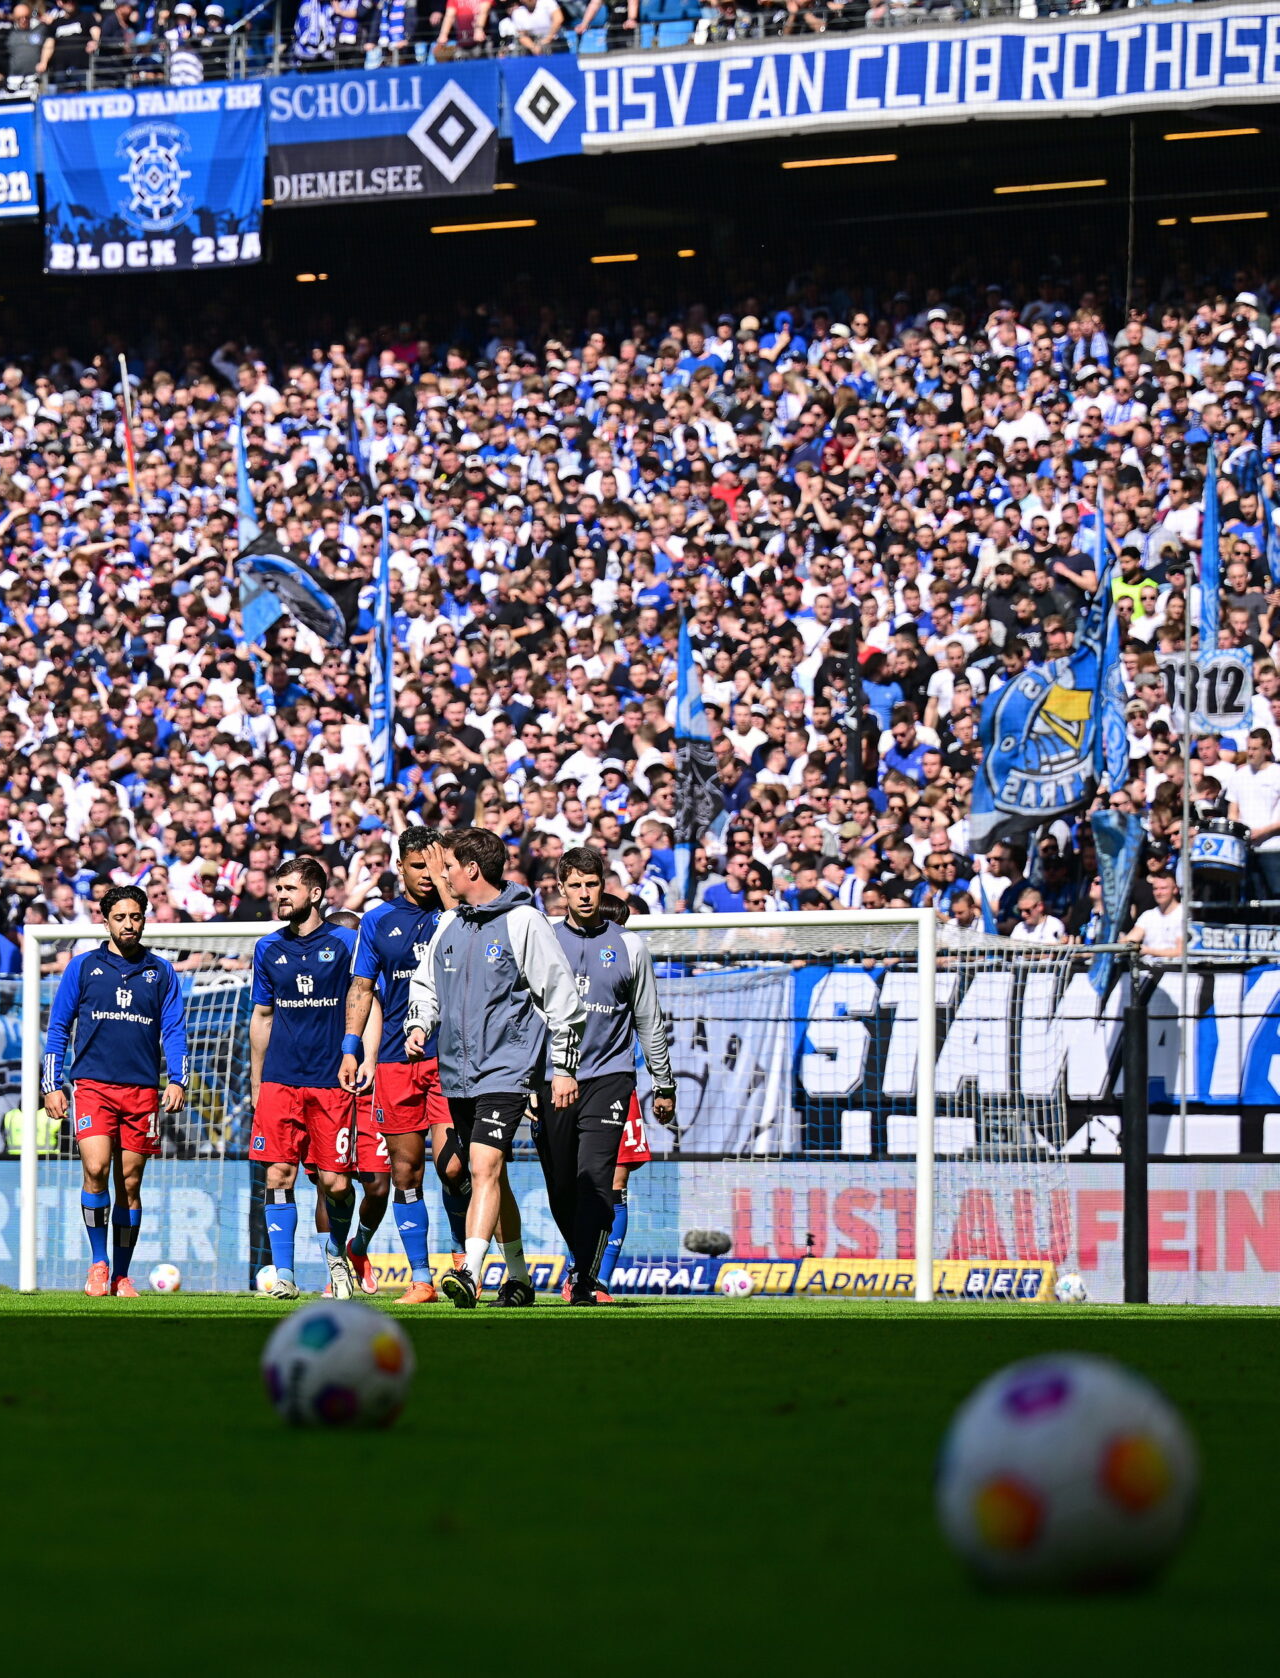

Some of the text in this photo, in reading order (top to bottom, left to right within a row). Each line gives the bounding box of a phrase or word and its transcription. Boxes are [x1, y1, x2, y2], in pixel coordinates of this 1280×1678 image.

[270, 76, 424, 122] SCHOLLI
[584, 61, 697, 132] HSV
[716, 50, 827, 122] FAN
[845, 36, 1002, 111] CLUB
[41, 92, 135, 122] UNITED
[136, 87, 223, 117] FAMILY
[272, 165, 425, 201] DIEMELSEE
[49, 231, 263, 269] BLOCK 23A
[91, 1010, 154, 1025] HanseMerkur
[335, 1127, 349, 1155] 6
[732, 1187, 917, 1259] LUST
[484, 1263, 550, 1284] BT
[748, 1269, 788, 1288] ET
[806, 1267, 1042, 1293] ADMIRL BET
